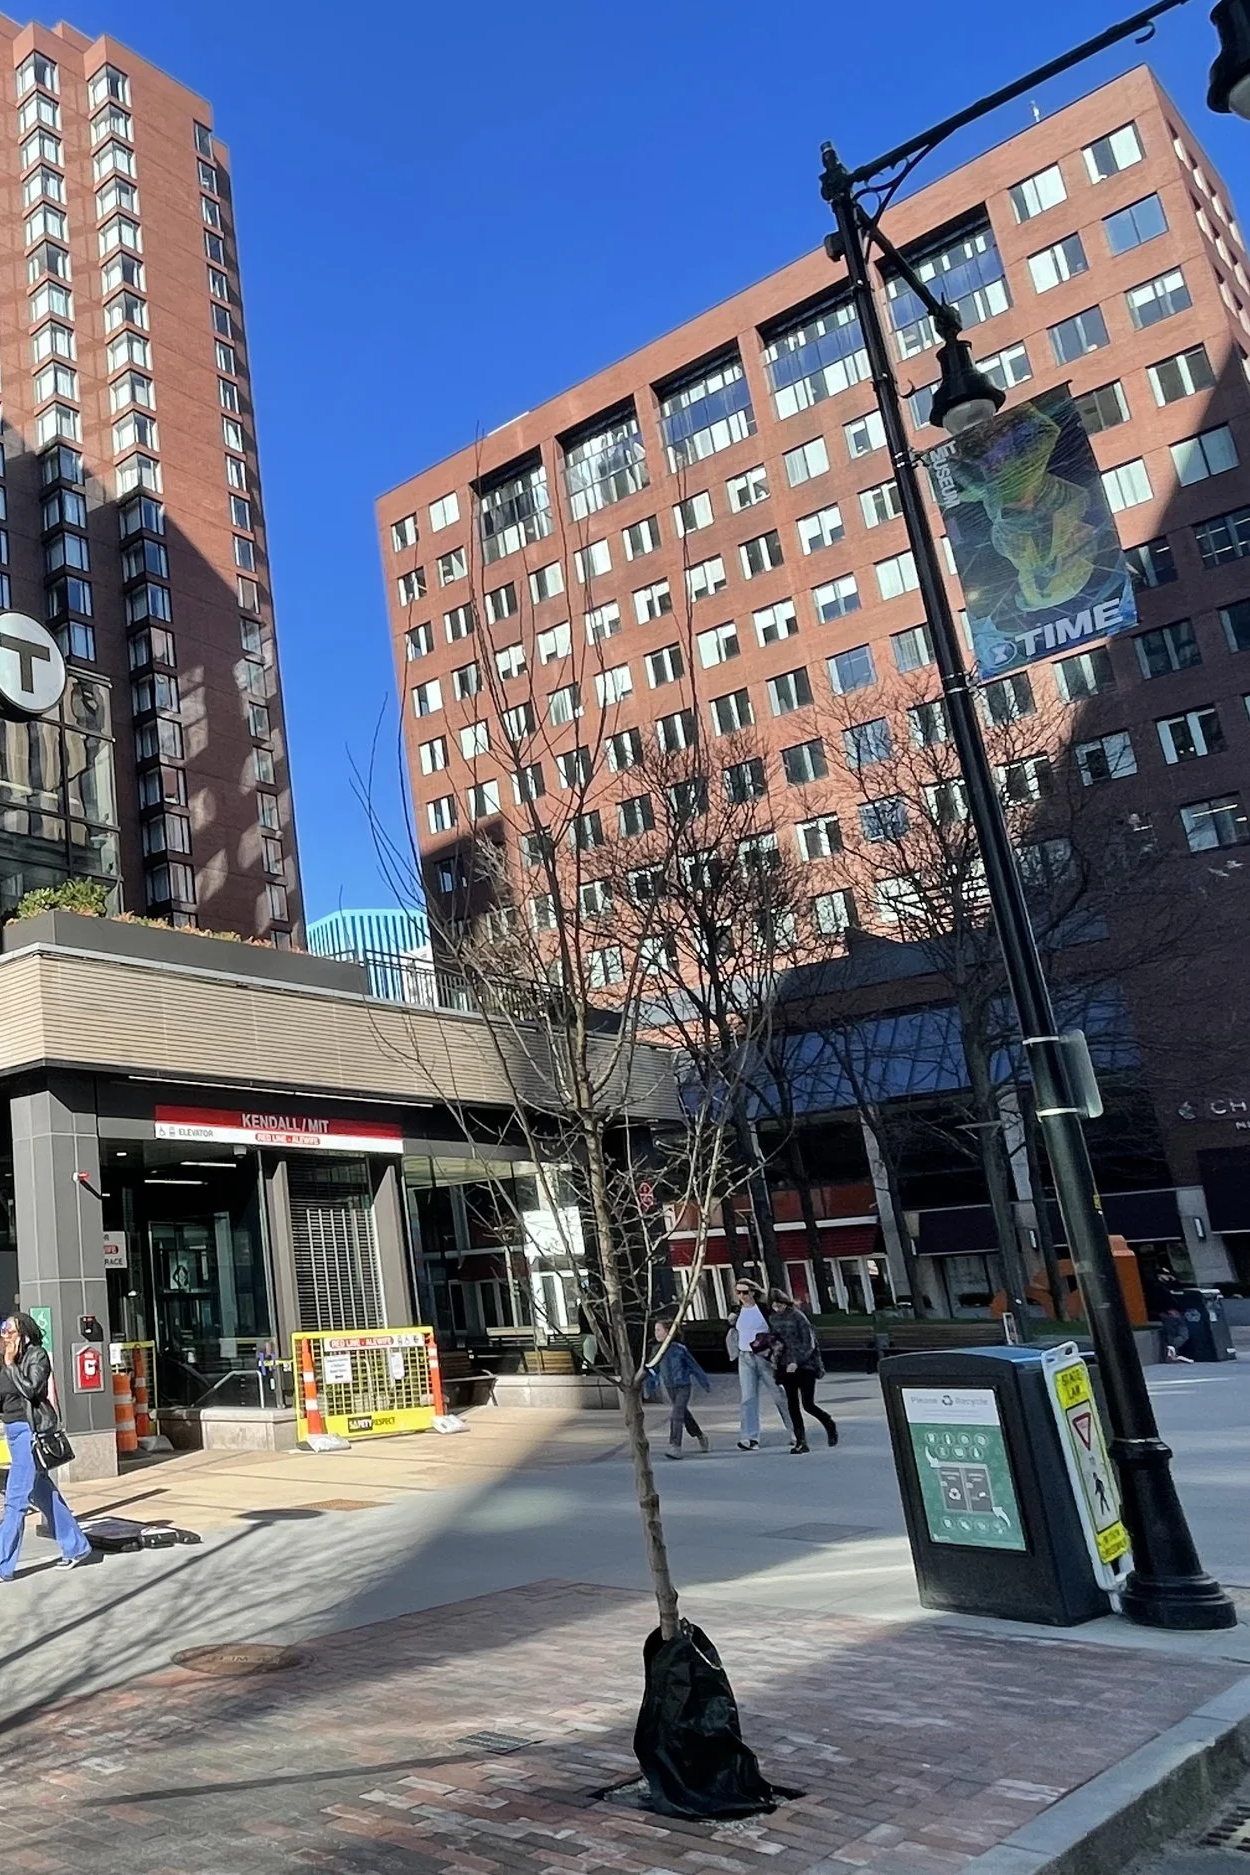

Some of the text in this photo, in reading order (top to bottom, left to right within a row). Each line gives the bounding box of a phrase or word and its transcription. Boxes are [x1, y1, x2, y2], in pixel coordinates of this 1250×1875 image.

[930, 440, 956, 462] MIT
[1015, 598, 1123, 656] TIME
[0, 631, 50, 694] T
[178, 1128, 213, 1137] ELEVATOR
[257, 1133, 271, 1141] RED
[272, 1134, 285, 1142] LINE
